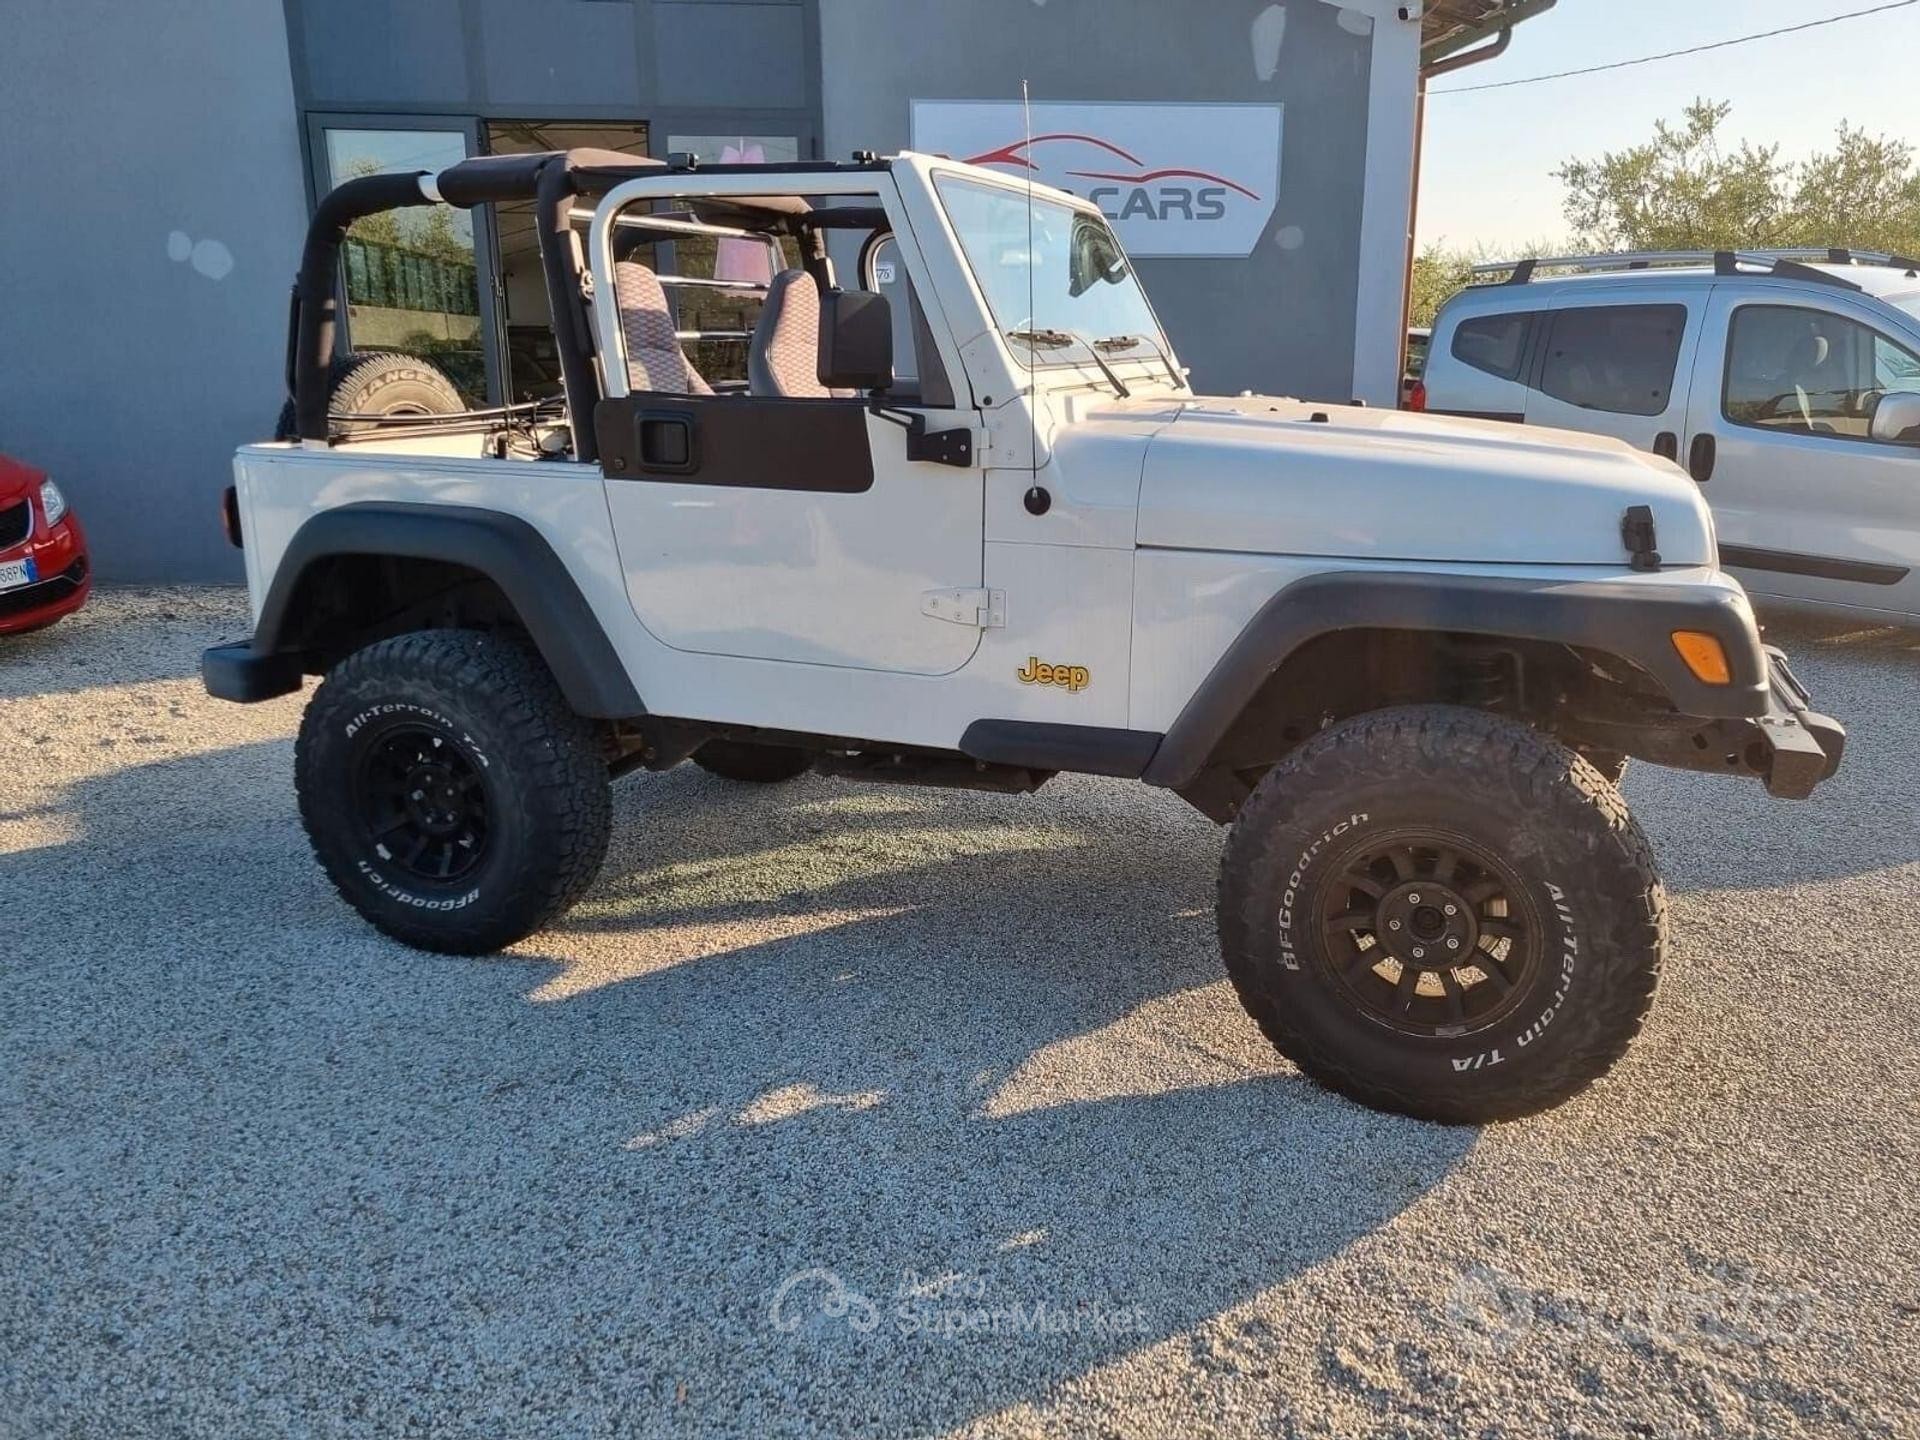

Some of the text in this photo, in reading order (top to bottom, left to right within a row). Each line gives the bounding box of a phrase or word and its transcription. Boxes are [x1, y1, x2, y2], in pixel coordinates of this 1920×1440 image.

[1090, 187, 1226, 221] CARS
[1017, 656, 1090, 692] Jeep
[345, 702, 453, 738] All-Terrain
[358, 860, 480, 911] BFGoodrich
[1278, 811, 1370, 971] BFGoodrich
[1451, 880, 1577, 1073] All-Terrain T/A
